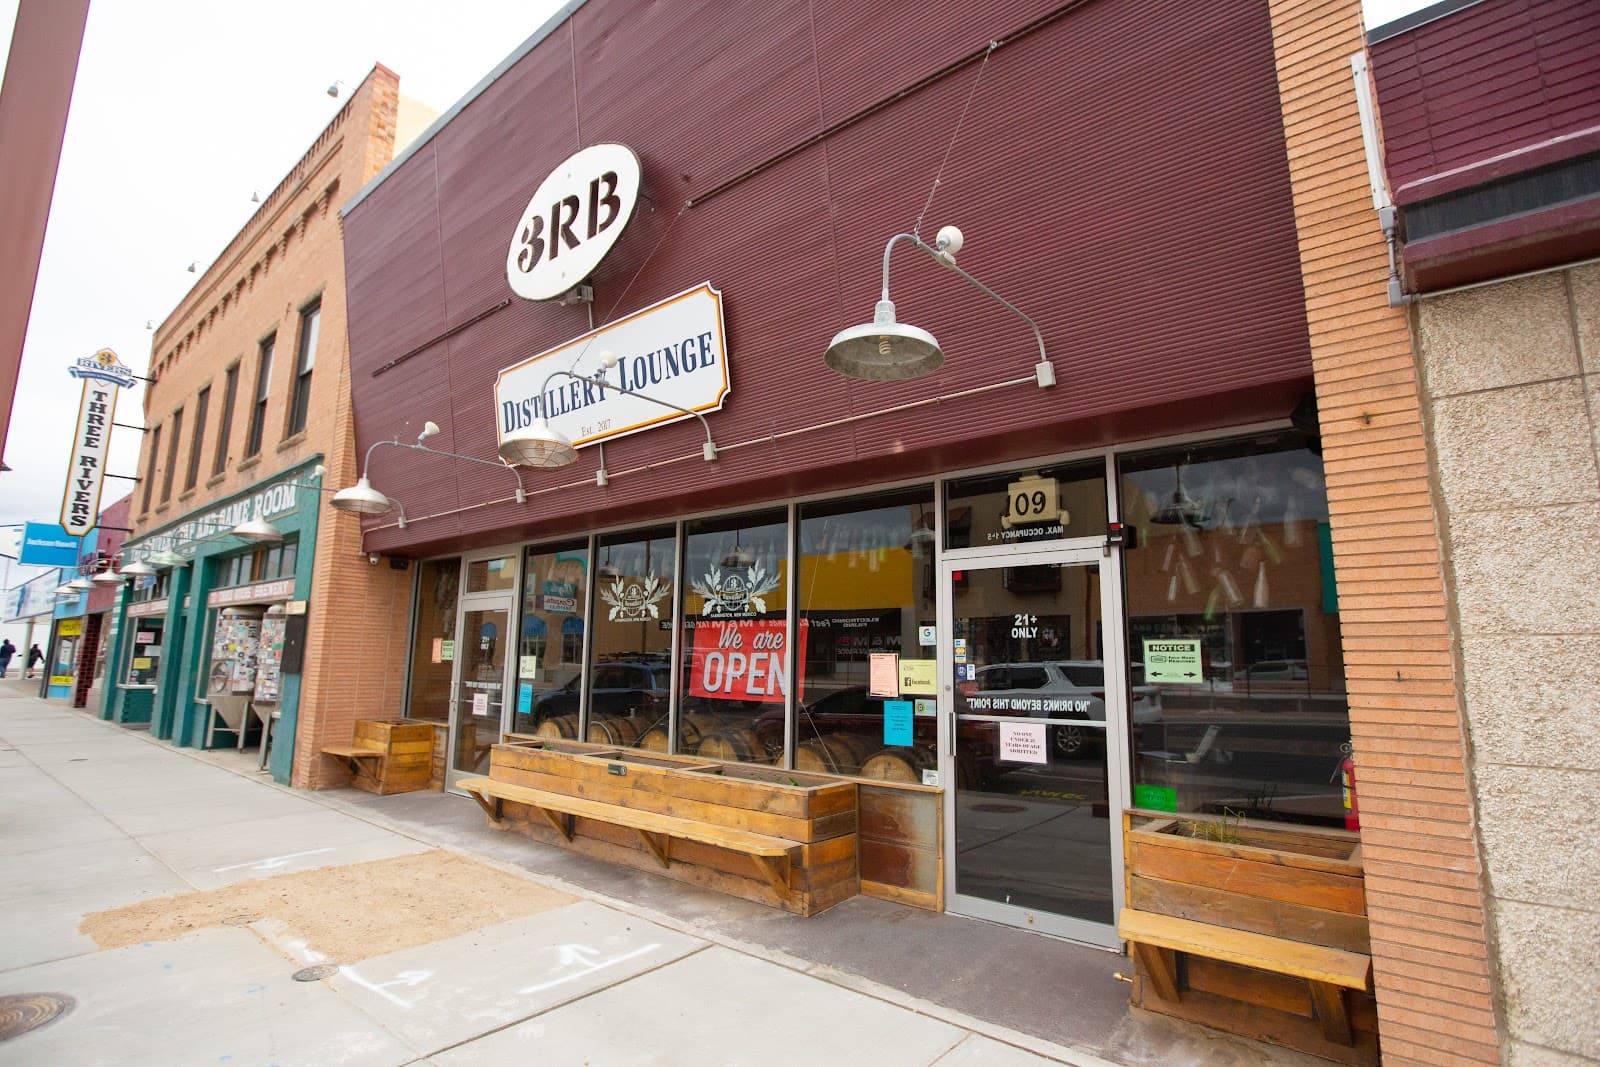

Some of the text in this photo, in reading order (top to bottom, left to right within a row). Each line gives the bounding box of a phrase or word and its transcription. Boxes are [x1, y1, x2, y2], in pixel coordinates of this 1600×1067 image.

[517, 171, 621, 273] 3RB
[617, 331, 715, 395] LOUNGE
[84, 390, 108, 448] THREE
[70, 455, 98, 527] RIVERS
[253, 479, 297, 520] ROOM
[718, 621, 784, 650] We are
[923, 628, 931, 638] G
[1011, 627, 1038, 638] ONLY
[1014, 614, 1038, 626] 21+
[1152, 644, 1192, 652] NOTICE
[703, 652, 787, 696] OPEN
